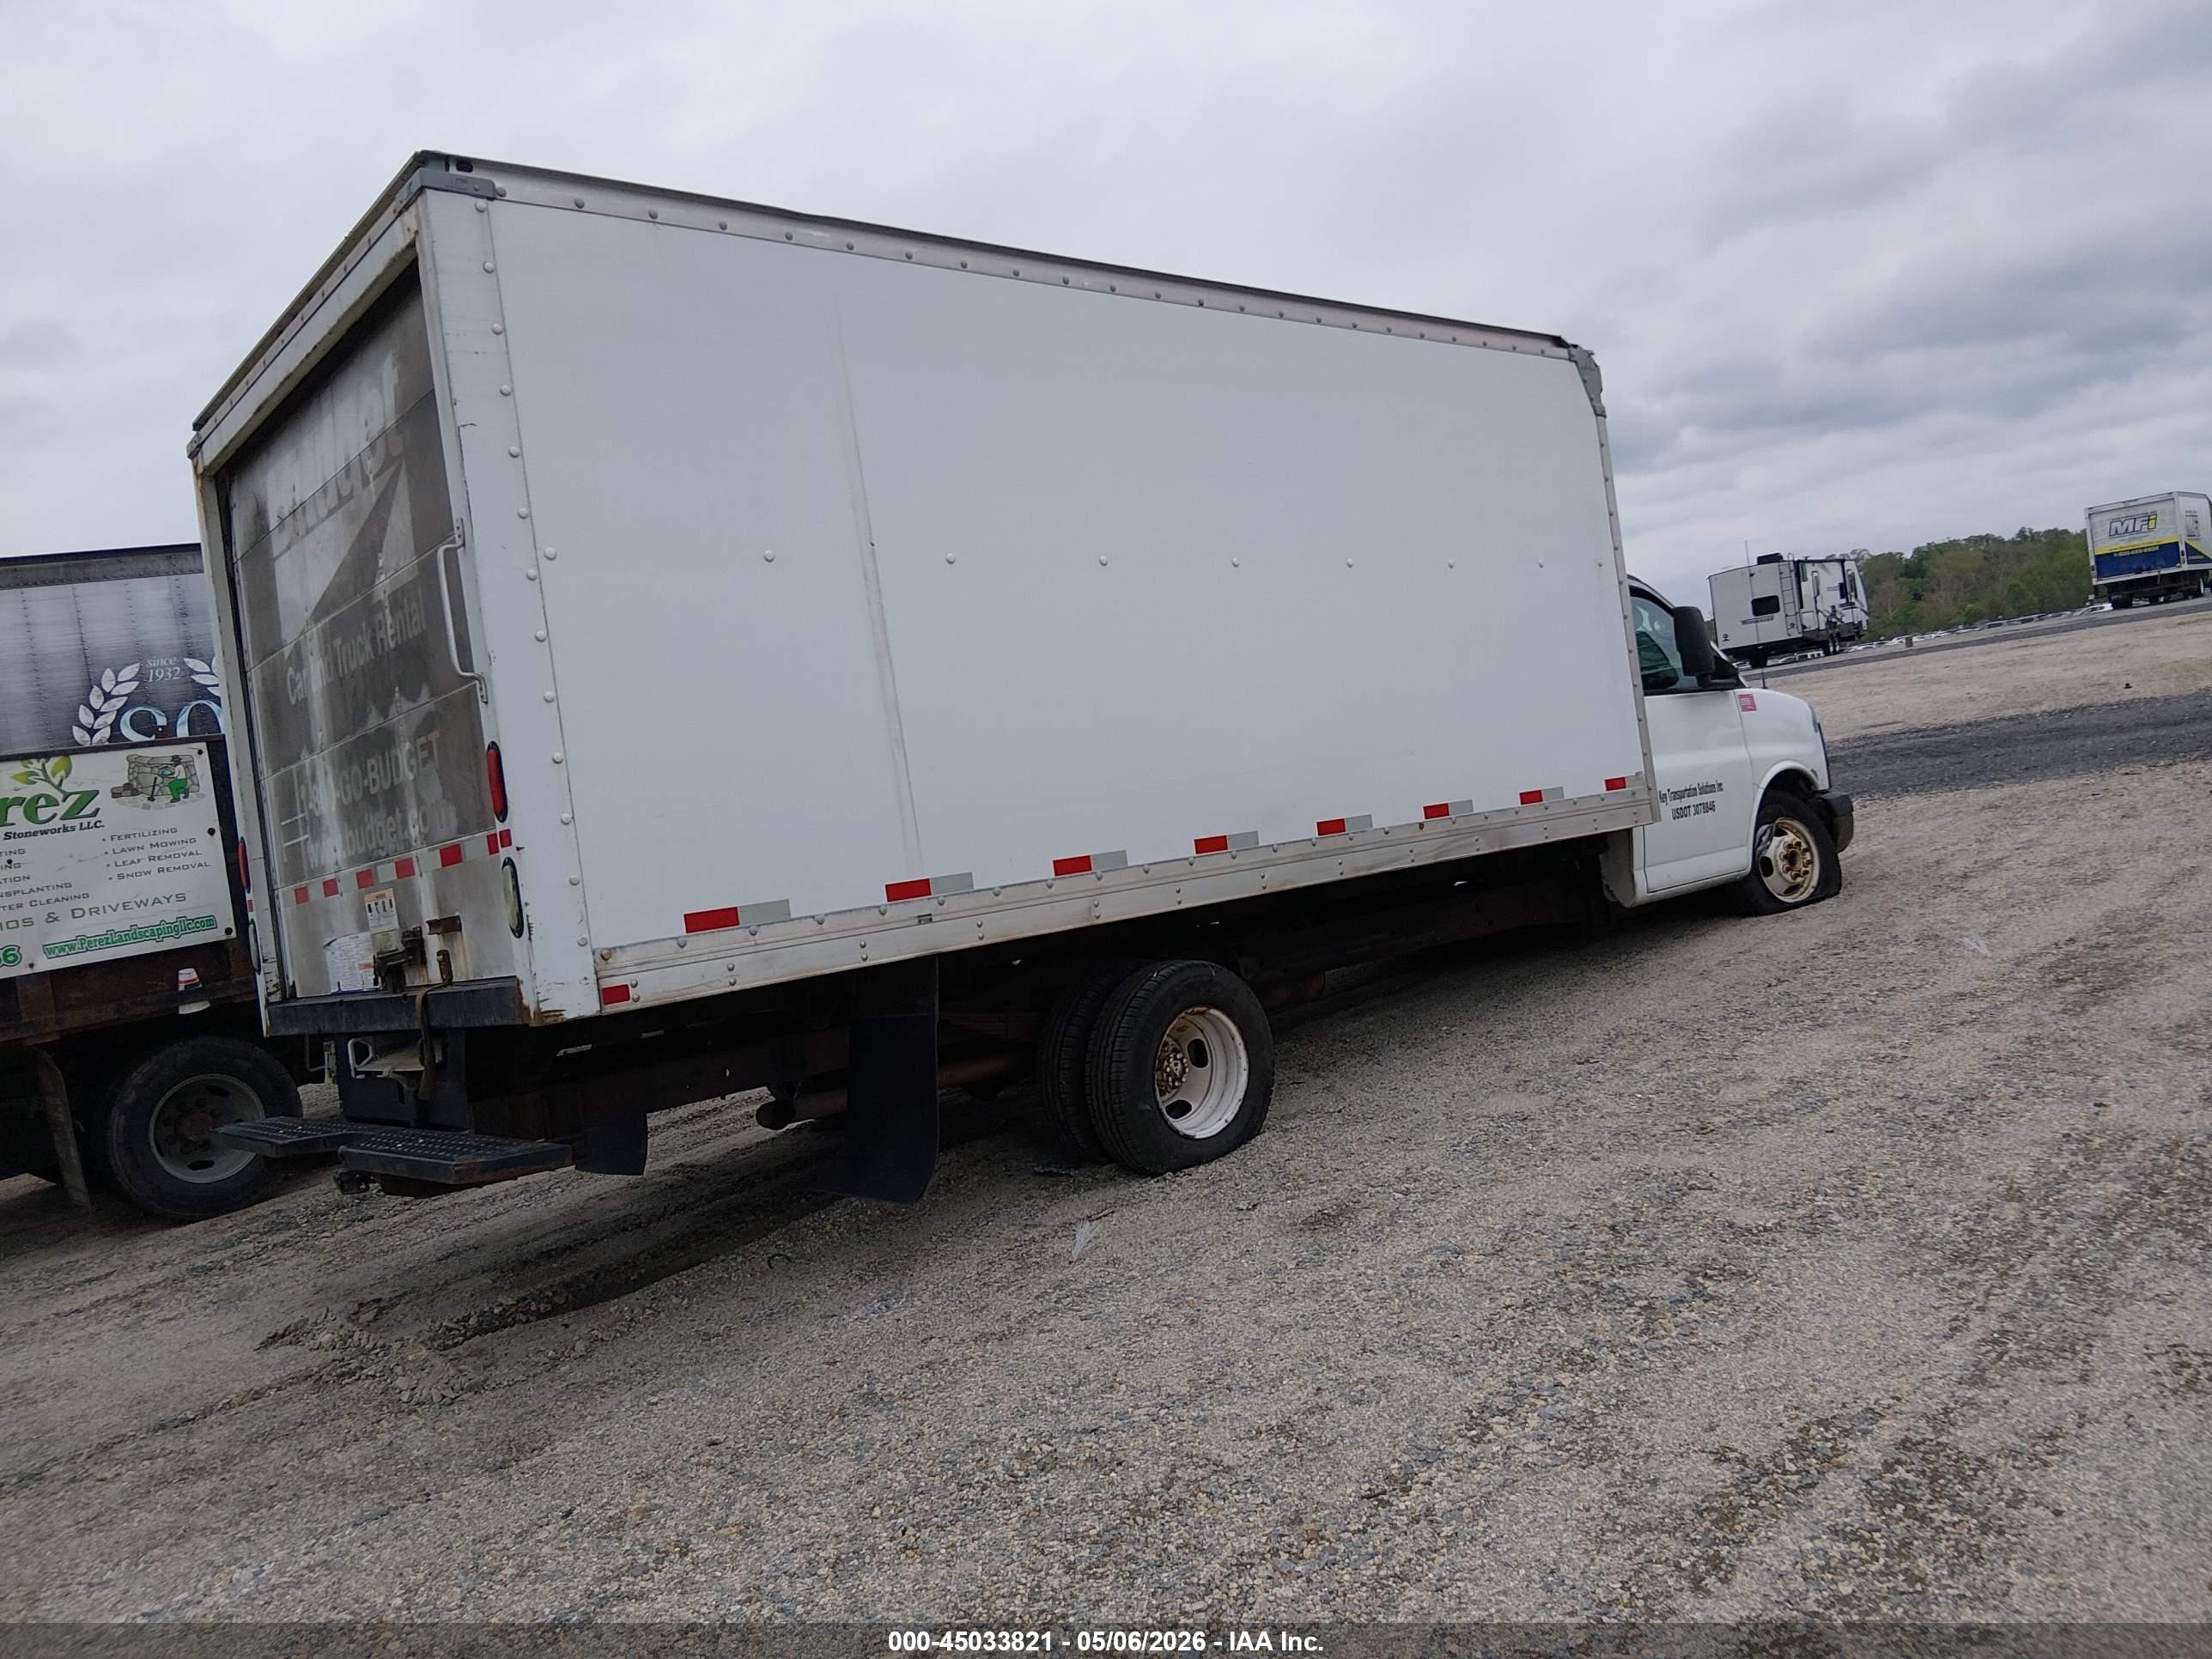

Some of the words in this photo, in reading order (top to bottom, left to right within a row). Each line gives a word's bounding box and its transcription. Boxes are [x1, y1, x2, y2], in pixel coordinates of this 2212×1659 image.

[287, 665, 307, 705] Car
[333, 621, 374, 678] Truck
[374, 588, 427, 655] Rental
[146, 656, 176, 667] since
[149, 667, 180, 682] 1932
[1667, 784, 1698, 803] Transportation
[1698, 781, 1717, 795] Solutions
[1671, 805, 1691, 820] USDOT
[3, 824, 76, 841] Stoneworks
[79, 820, 105, 831] LLC.
[112, 845, 144, 854] LAWN
[149, 837, 197, 849] MOWING
[148, 850, 203, 862] REMOVAL
[117, 870, 151, 879] SNOW
[157, 861, 211, 874] REMOVAL
[29, 893, 90, 907] CLEANING
[45, 912, 60, 923] &
[70, 893, 186, 919] DRIVEWAYS
